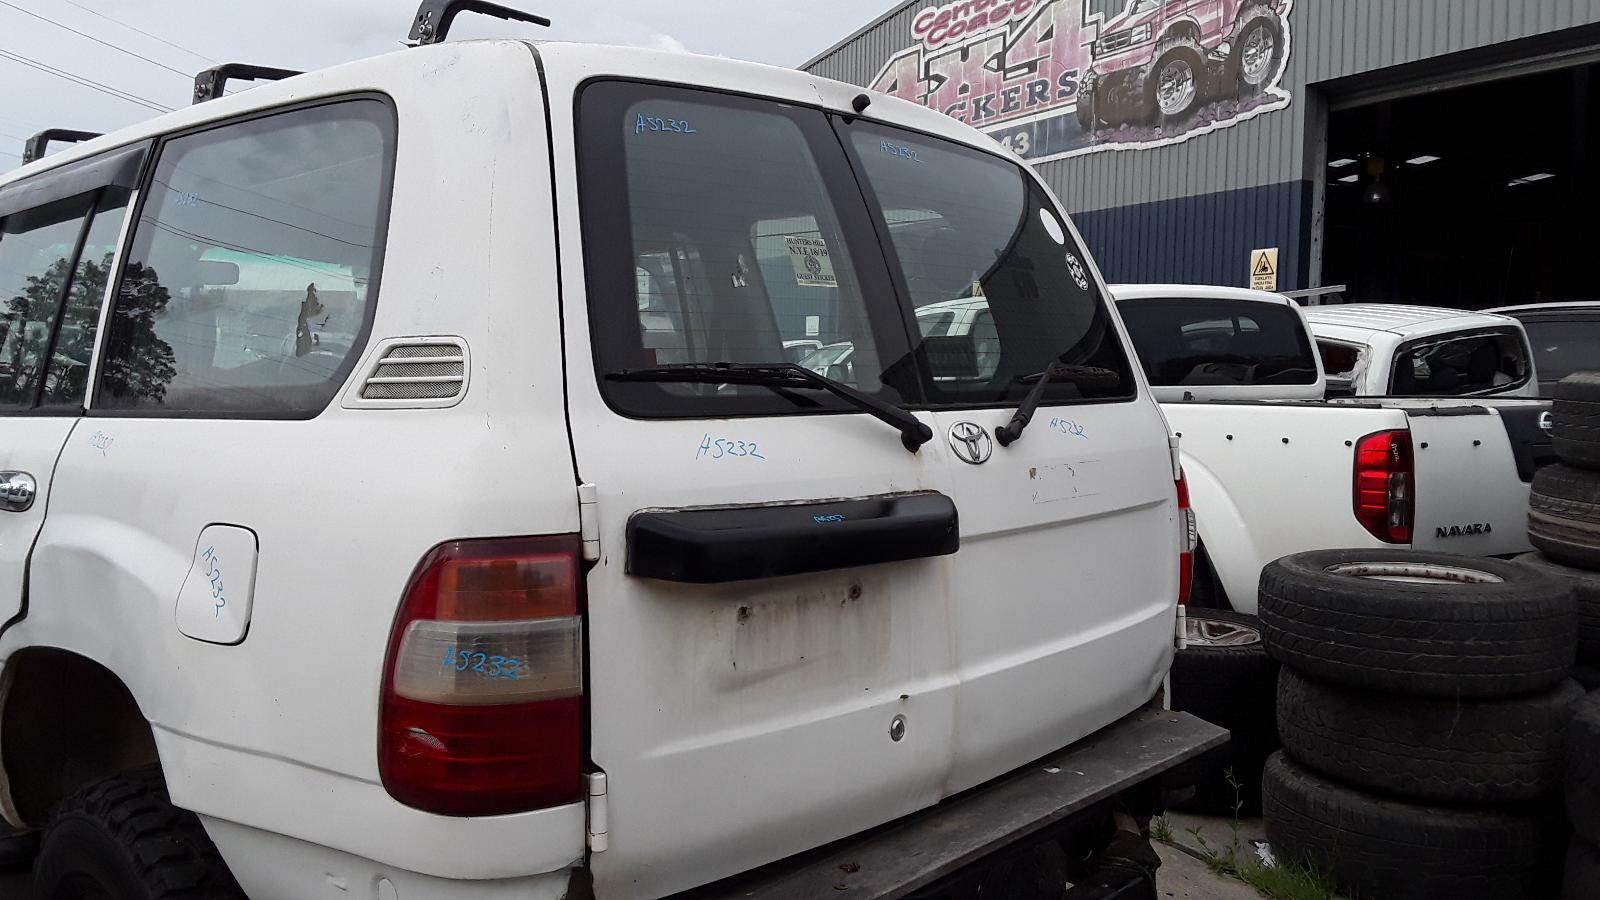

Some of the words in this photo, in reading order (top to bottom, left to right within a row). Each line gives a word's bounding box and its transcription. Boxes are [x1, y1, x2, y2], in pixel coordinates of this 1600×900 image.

[927, 0, 1034, 45] Coast
[944, 69, 1080, 122] CKERS
[1001, 131, 1031, 155] 43
[1435, 522, 1492, 538] NAVARA
